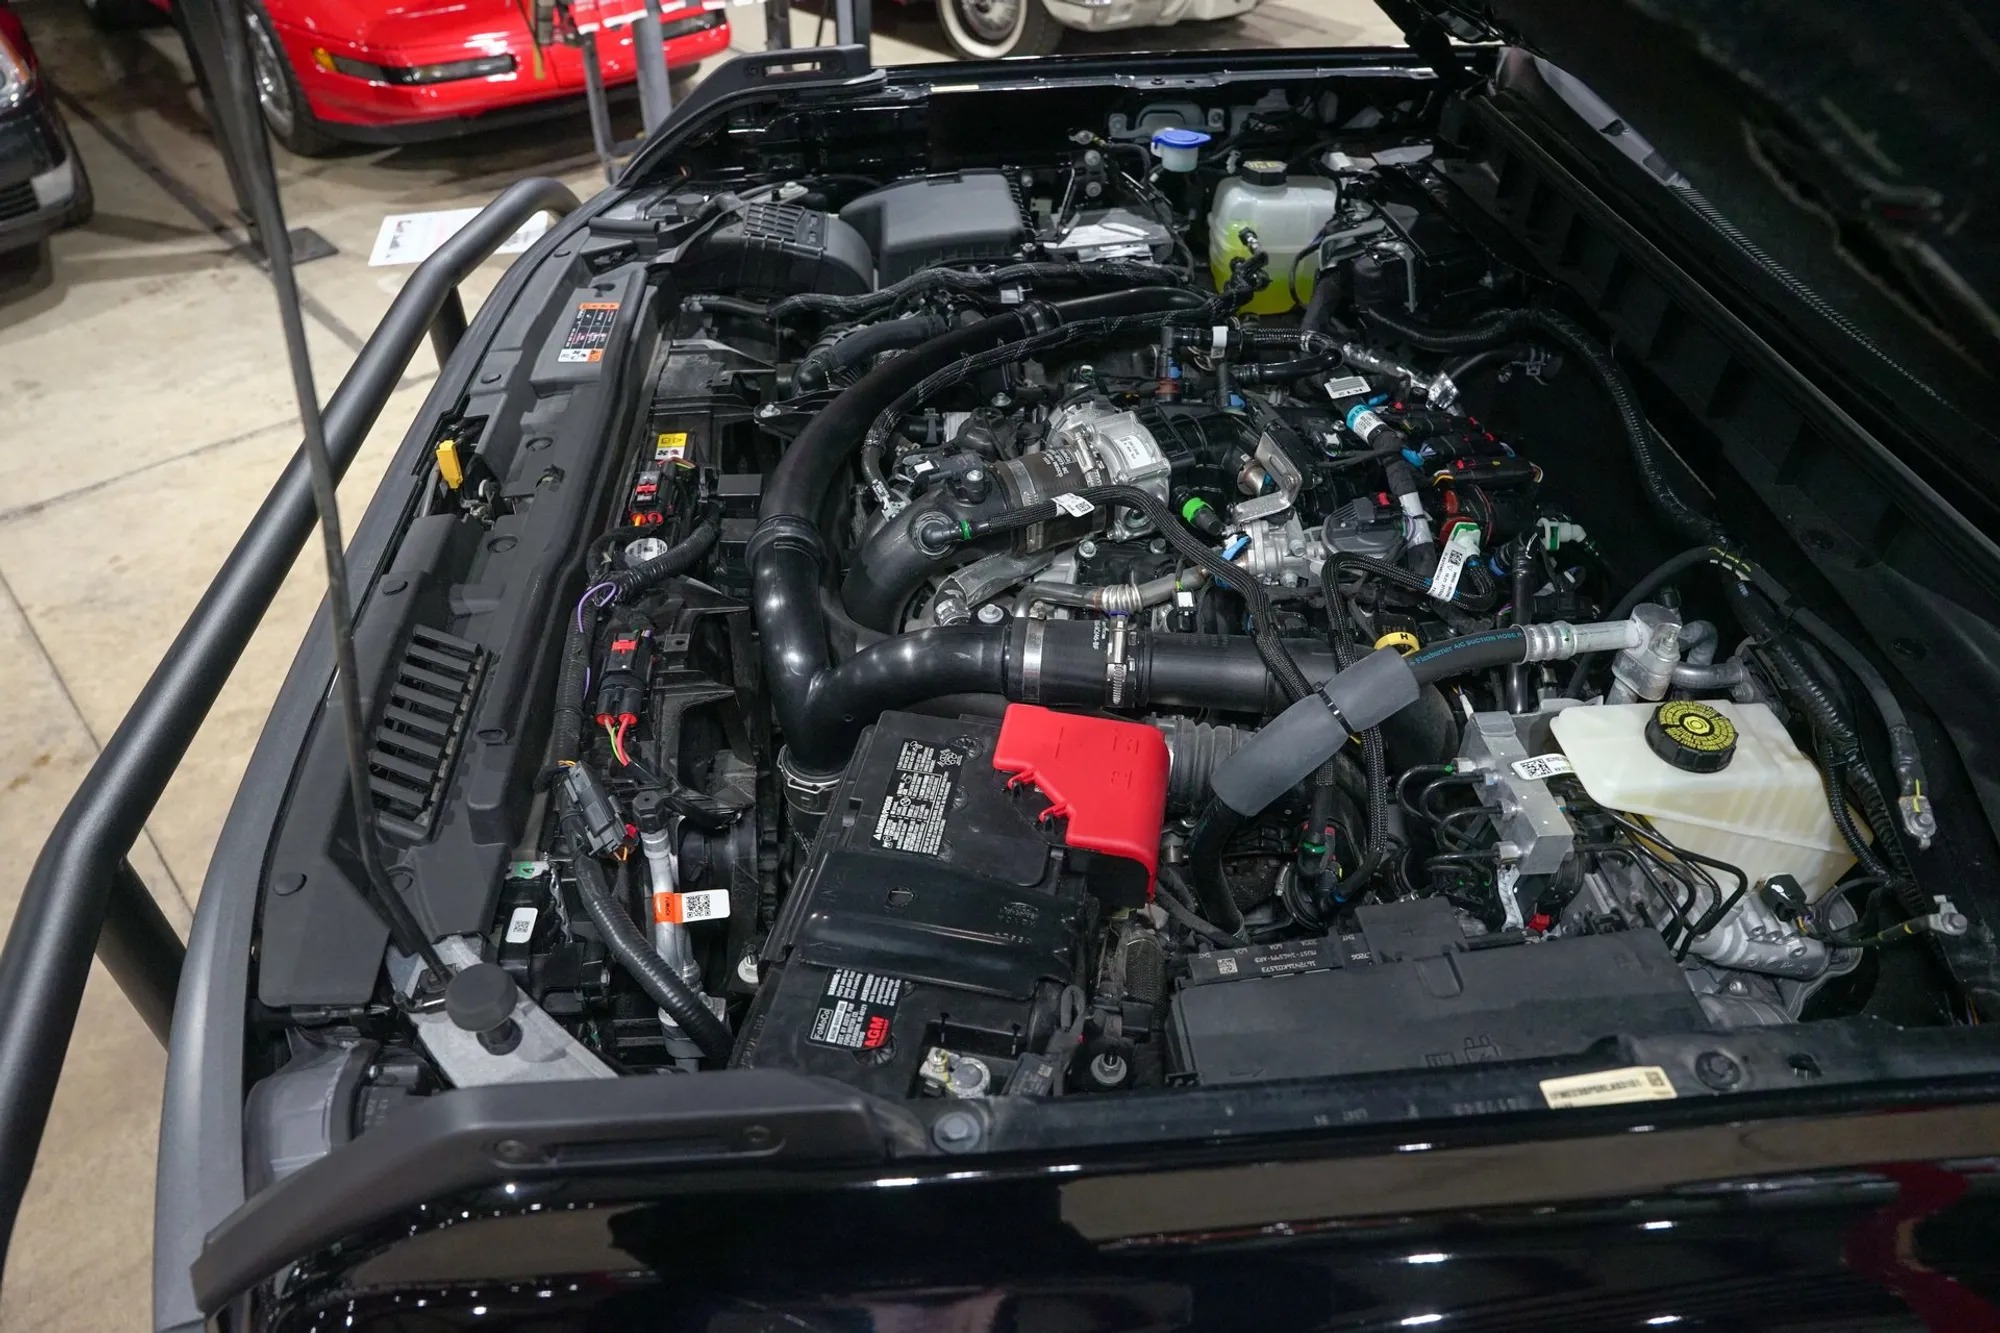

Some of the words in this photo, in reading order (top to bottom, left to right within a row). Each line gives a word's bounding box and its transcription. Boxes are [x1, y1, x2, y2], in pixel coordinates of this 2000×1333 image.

[1454, 640, 1466, 649] A/C
[1466, 636, 1497, 646] SUCTION
[1496, 632, 1517, 640] HOSE
[814, 1010, 830, 1039] FoMoCo
[864, 1016, 884, 1047] AGM
